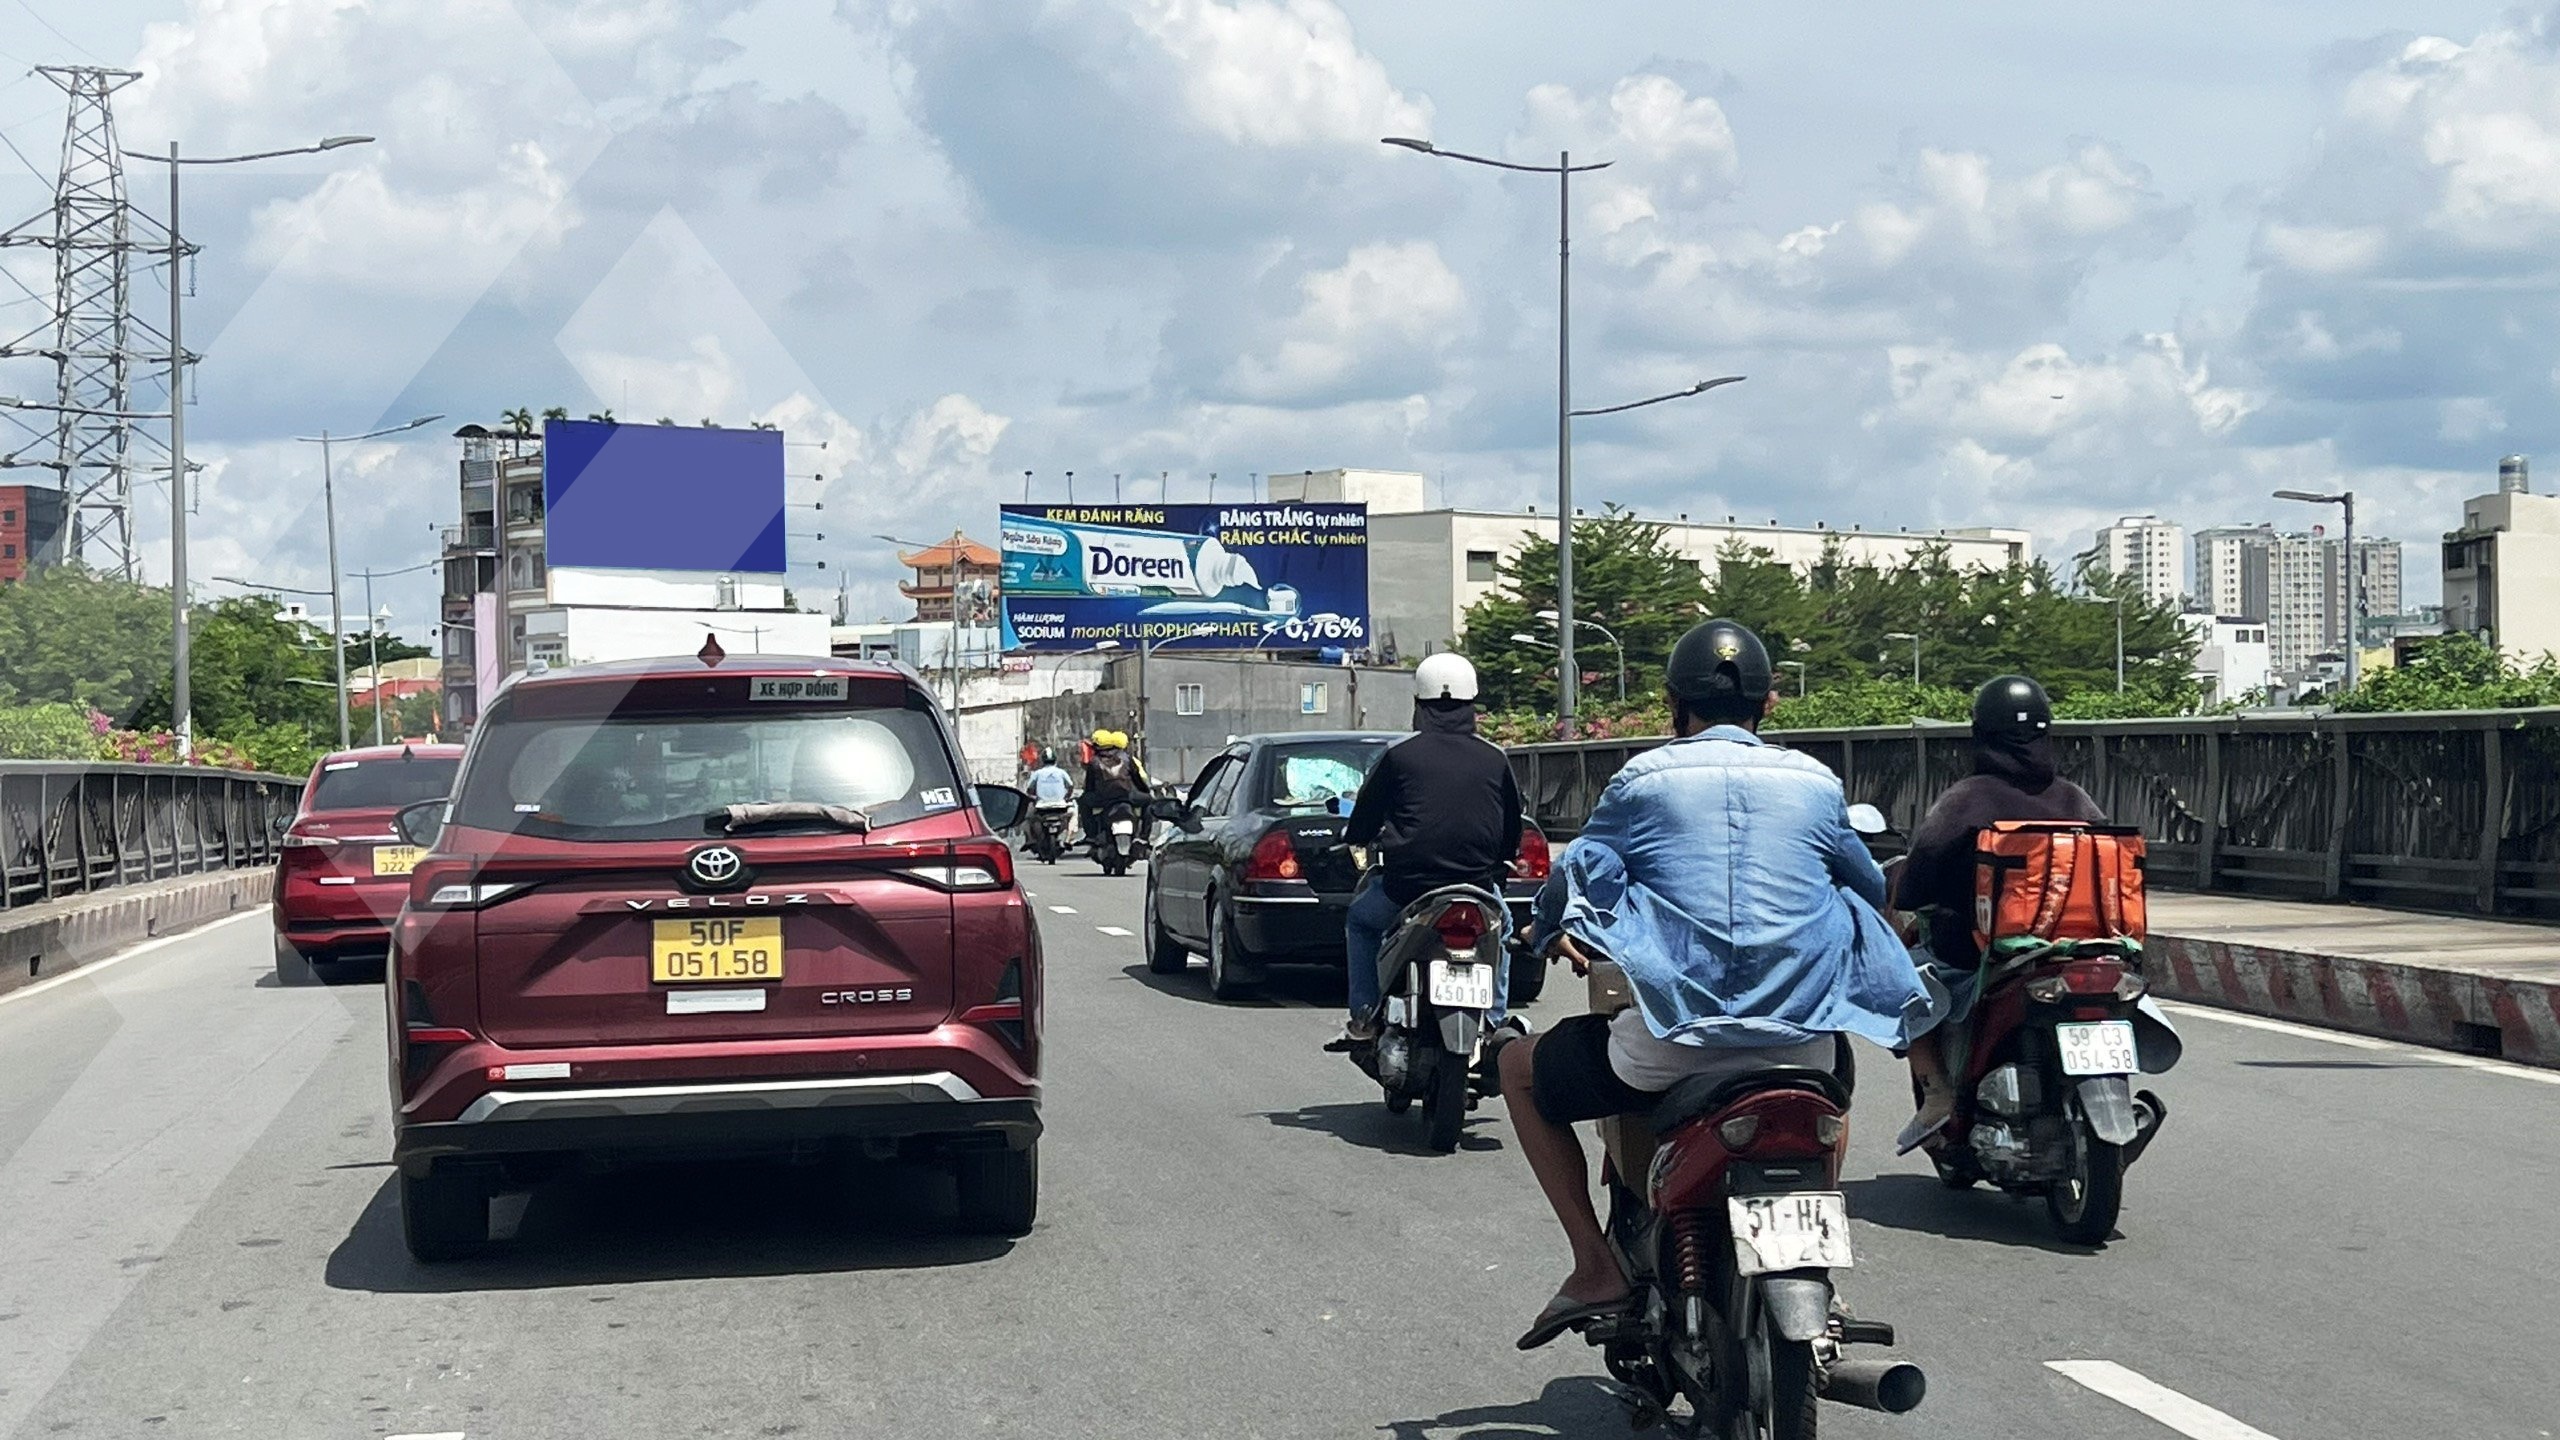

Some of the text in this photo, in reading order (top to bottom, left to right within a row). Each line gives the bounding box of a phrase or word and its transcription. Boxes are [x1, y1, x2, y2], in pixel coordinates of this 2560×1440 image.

[1046, 507, 1165, 524] KEM ĐÁNH RĂNG
[1220, 509, 1262, 527] RĂNG
[1220, 529, 1265, 545] RĂNG
[1089, 545, 1184, 579] Doreen
[1018, 626, 1066, 639] SODIUM
[760, 681, 775, 696] XE
[626, 893, 809, 910] VELOZ
[690, 920, 745, 946] 50F
[667, 949, 768, 977] 051.58
[821, 988, 912, 1004] CROSS
